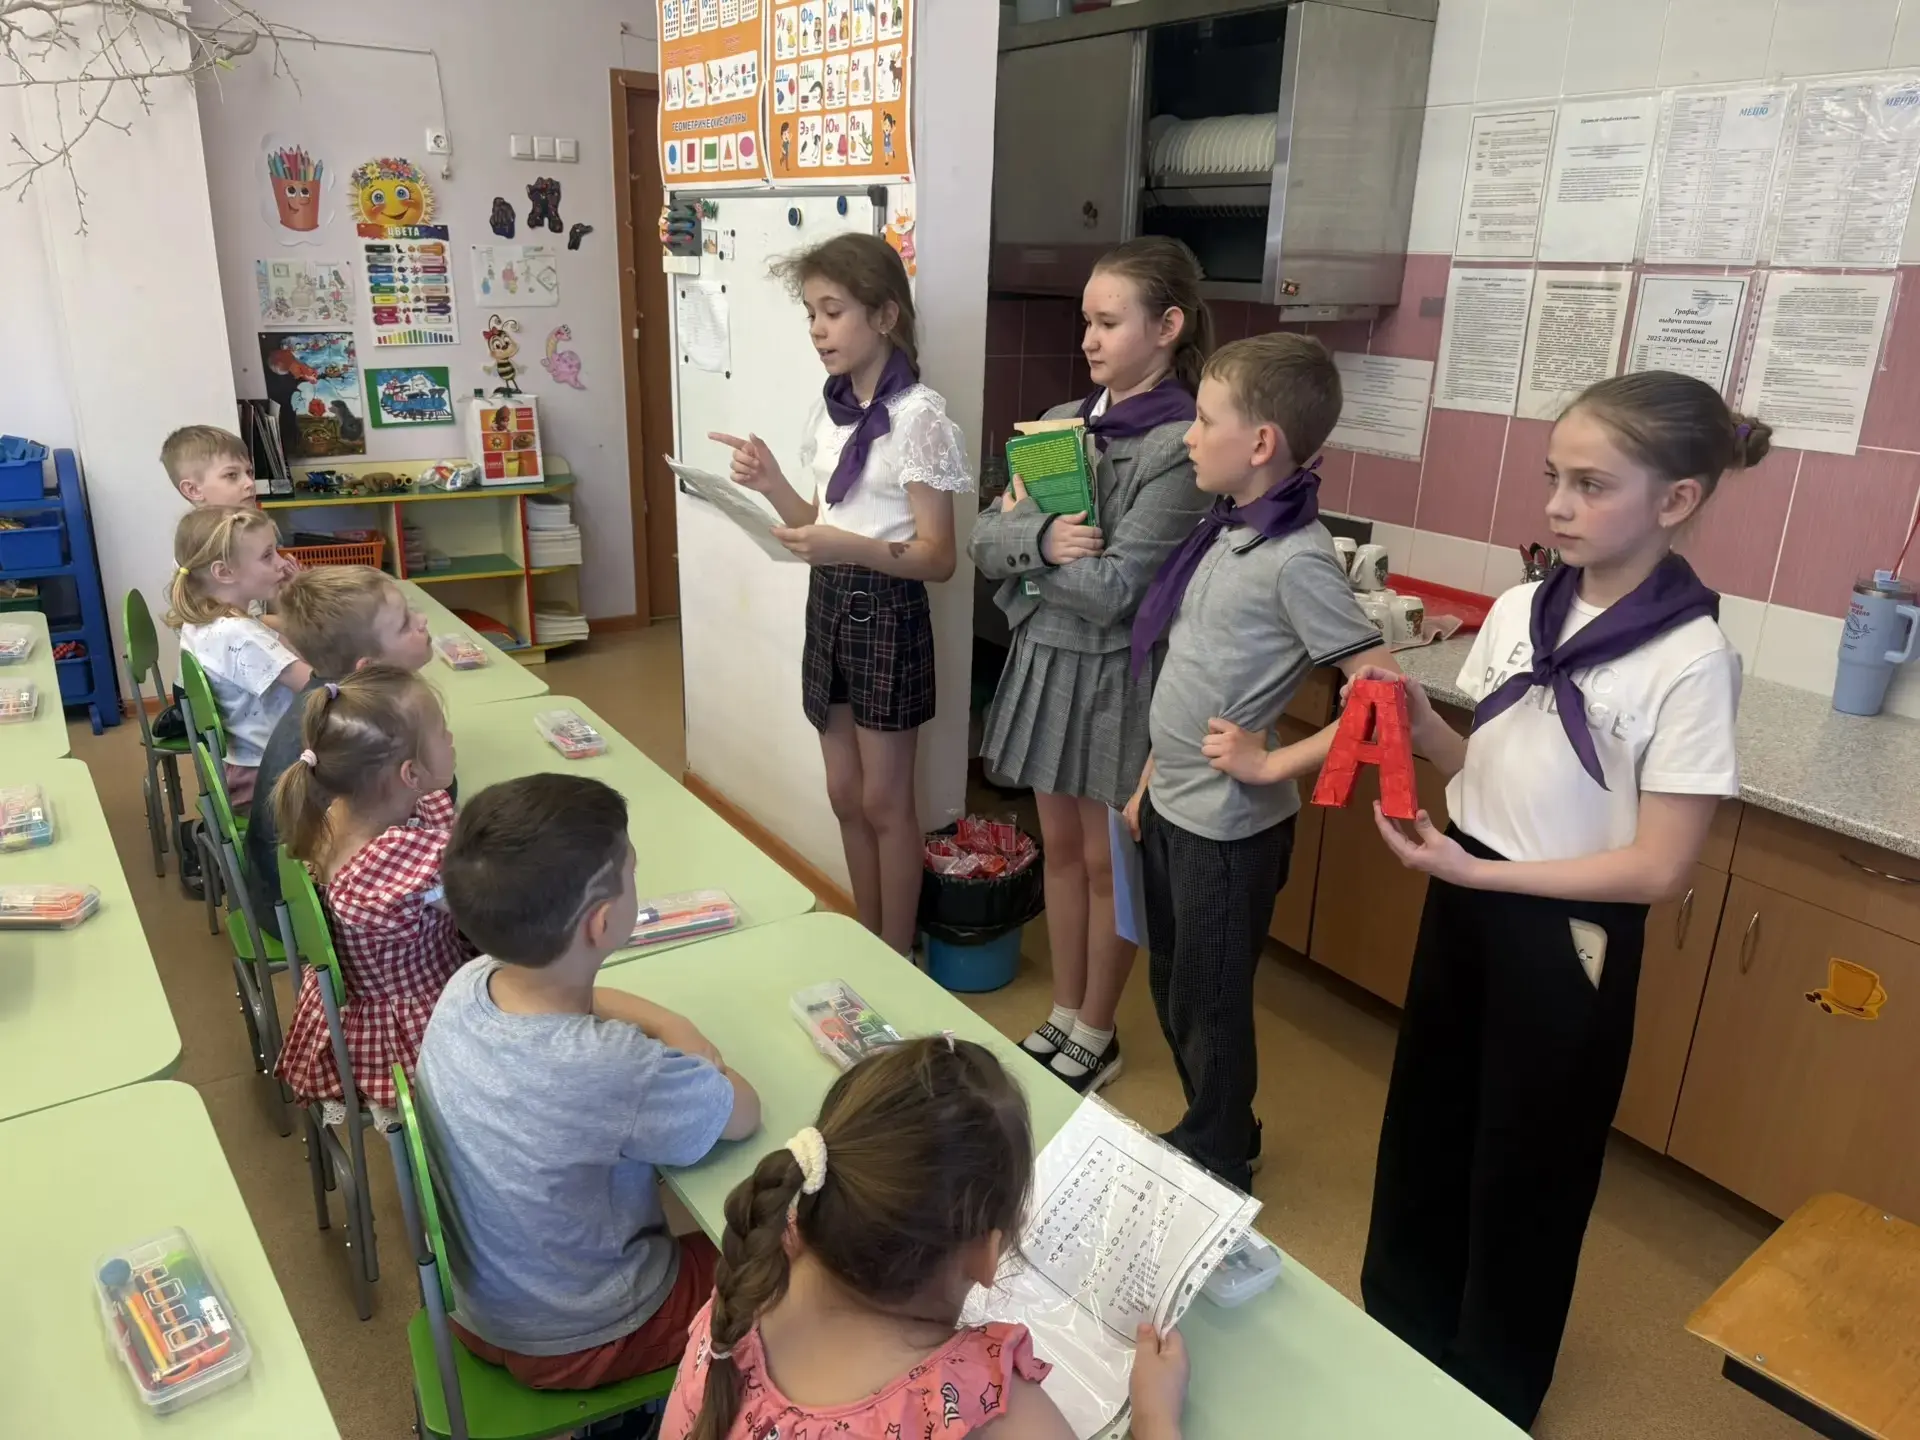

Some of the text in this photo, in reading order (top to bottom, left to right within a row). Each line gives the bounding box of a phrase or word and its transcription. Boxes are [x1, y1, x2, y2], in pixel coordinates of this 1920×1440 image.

[801, 7, 814, 25] Фф
[1738, 106, 1769, 117] МЕНЮ
[671, 117, 724, 133] ГЕОМЕТРИЧЕСКИЕ
[825, 118, 840, 134] Юю
[849, 115, 861, 132] Яя
[387, 226, 421, 237] ЦВЕТА
[1674, 308, 1699, 317] График
[1670, 327, 1705, 336] пищеблоке
[1678, 337, 1706, 346] учебный
[1706, 338, 1718, 346] год
